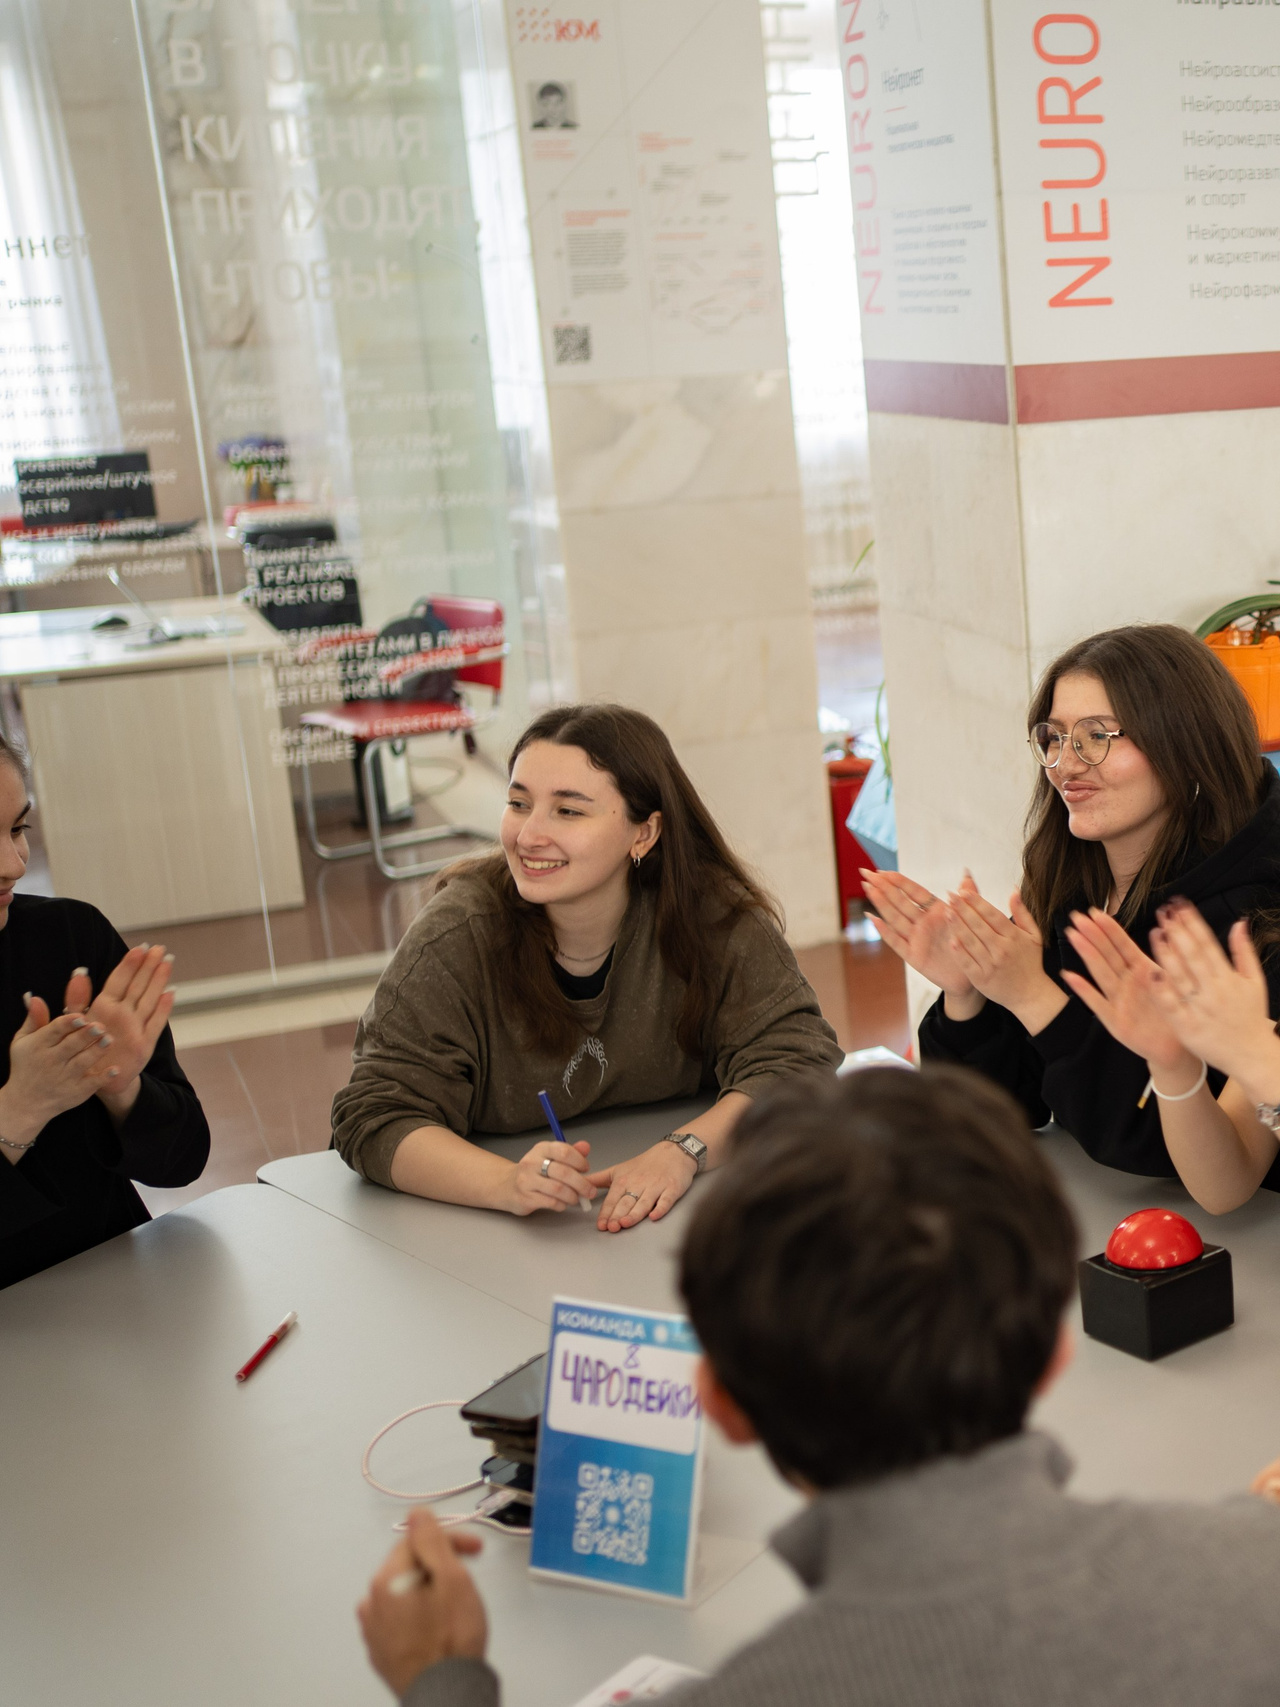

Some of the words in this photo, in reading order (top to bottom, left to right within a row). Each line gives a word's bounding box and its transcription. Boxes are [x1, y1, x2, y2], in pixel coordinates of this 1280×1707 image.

[170, 38, 207, 86] В
[1032, 13, 1114, 308] NEURO
[1185, 194, 1196, 206] и
[1201, 191, 1248, 208] спорт
[1188, 252, 1199, 264] и
[556, 1310, 647, 1341] КОМАНДА
[561, 1349, 701, 1420] ЧАРОДЕЙКИ
